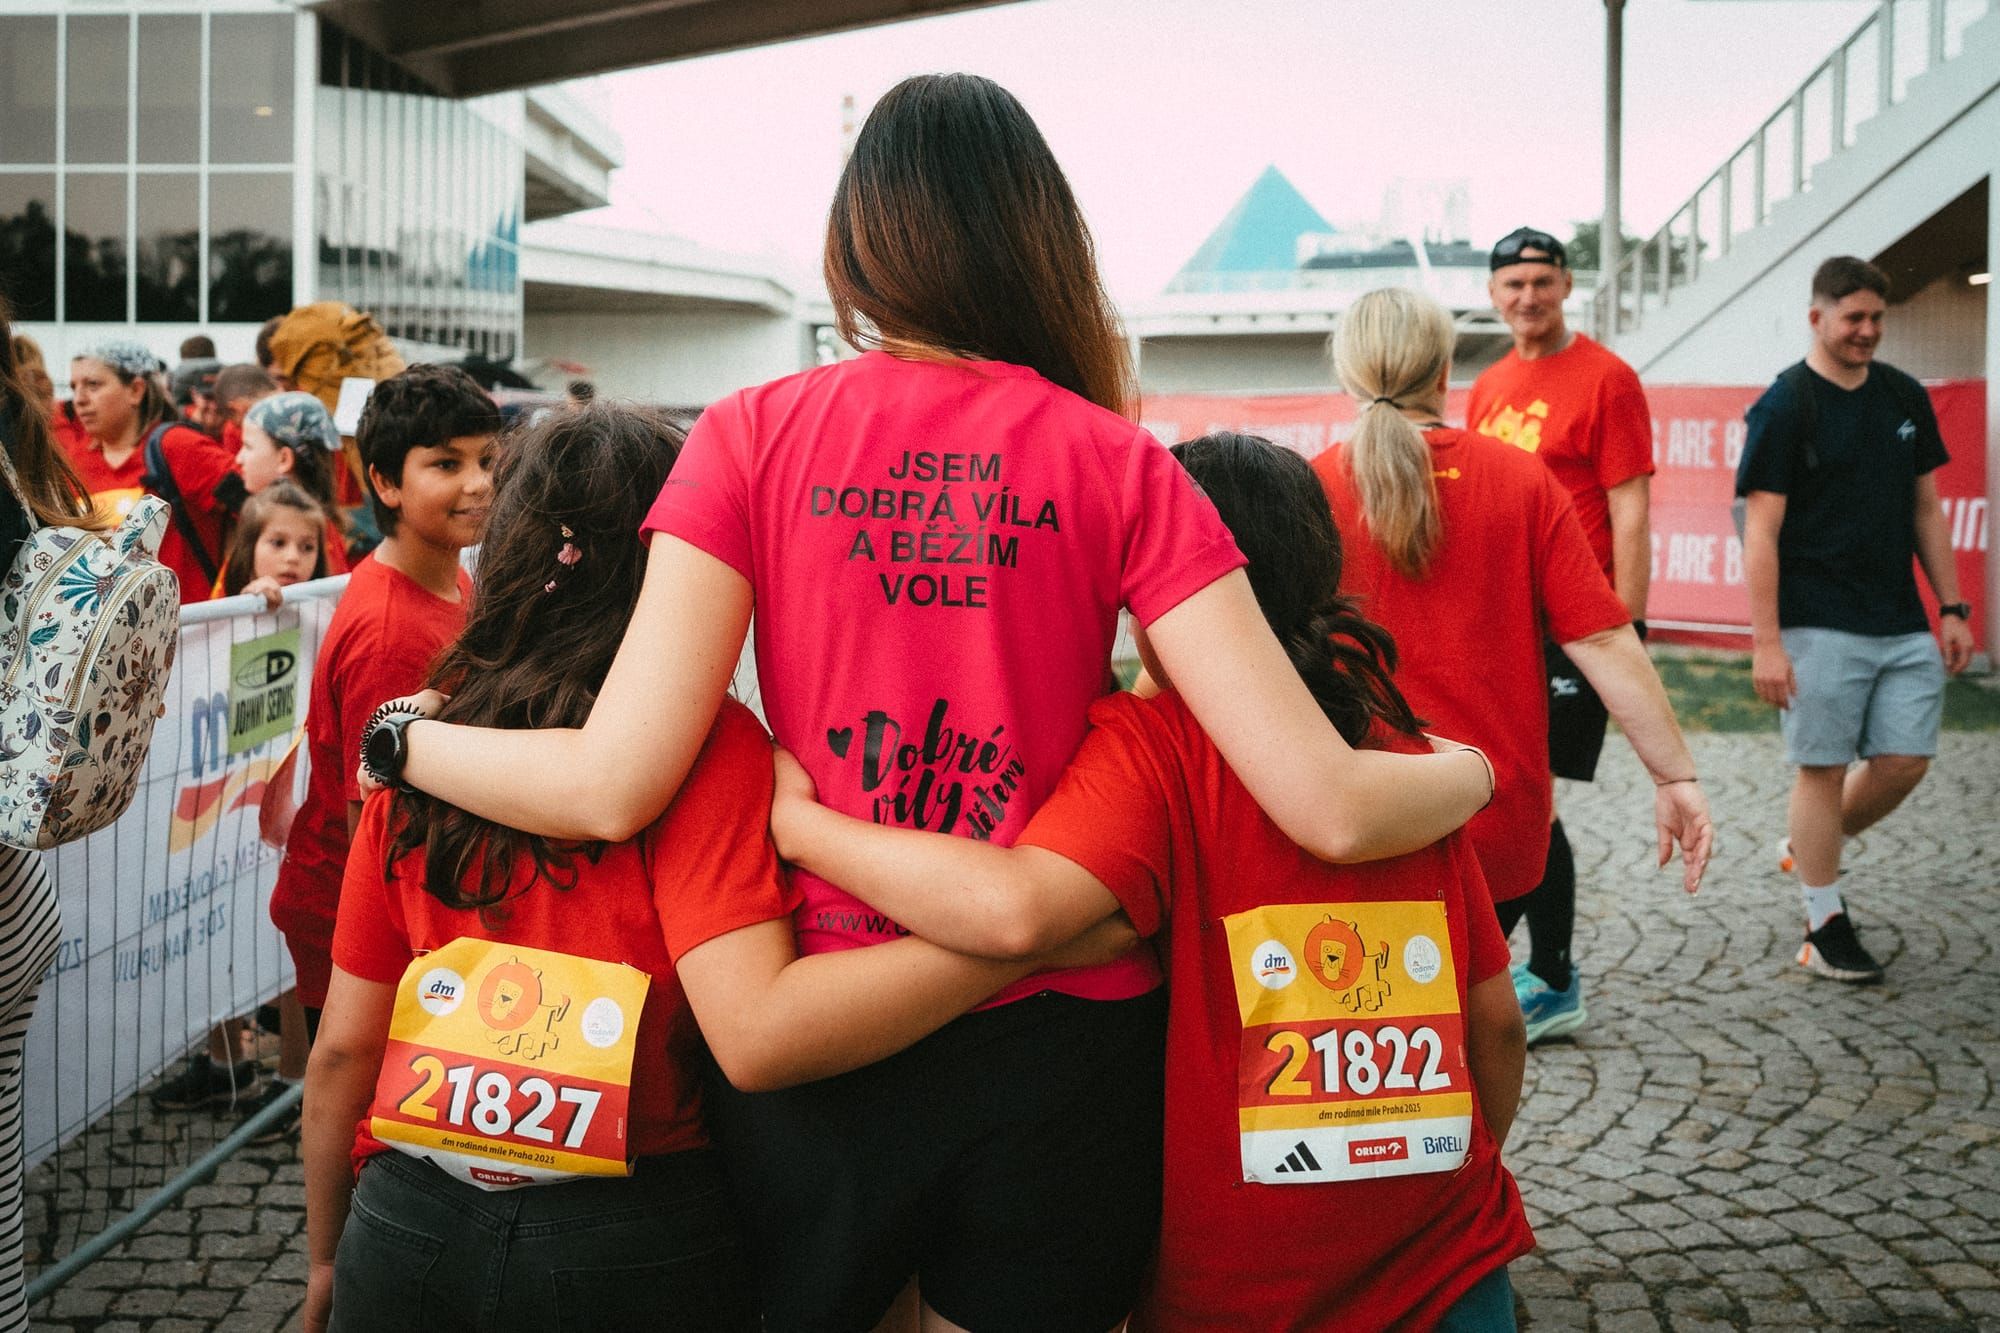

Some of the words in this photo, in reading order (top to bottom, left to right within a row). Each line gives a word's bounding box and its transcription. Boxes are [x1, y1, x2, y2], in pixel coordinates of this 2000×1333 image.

[888, 450, 1001, 483] JSEM
[811, 485, 957, 522] DOBRÁ
[971, 486, 1061, 533] VÍLA
[848, 529, 877, 562] A
[890, 523, 1019, 569] BĚŽÍM
[878, 573, 988, 608] VOLE
[233, 692, 265, 736] JOHNNY
[267, 682, 294, 722] SERVIS
[861, 698, 1012, 792] Dobré
[1264, 953, 1287, 969] dm
[430, 979, 455, 997] dm
[1266, 1025, 1452, 1096] 21822
[398, 1055, 602, 1148] 21827
[1318, 1109, 1333, 1120] dm
[1334, 1107, 1365, 1119] rodinná
[1366, 1105, 1381, 1117] mile
[1382, 1104, 1404, 1115] Praha
[1405, 1103, 1421, 1114] 2025
[441, 1137, 455, 1147] dm
[456, 1140, 488, 1152] rodinná
[489, 1145, 507, 1157] mile
[508, 1148, 533, 1161] Praha
[534, 1153, 556, 1165] 2025
[1355, 1145, 1387, 1157] ORLEN
[476, 1172, 510, 1183] ORLEN
